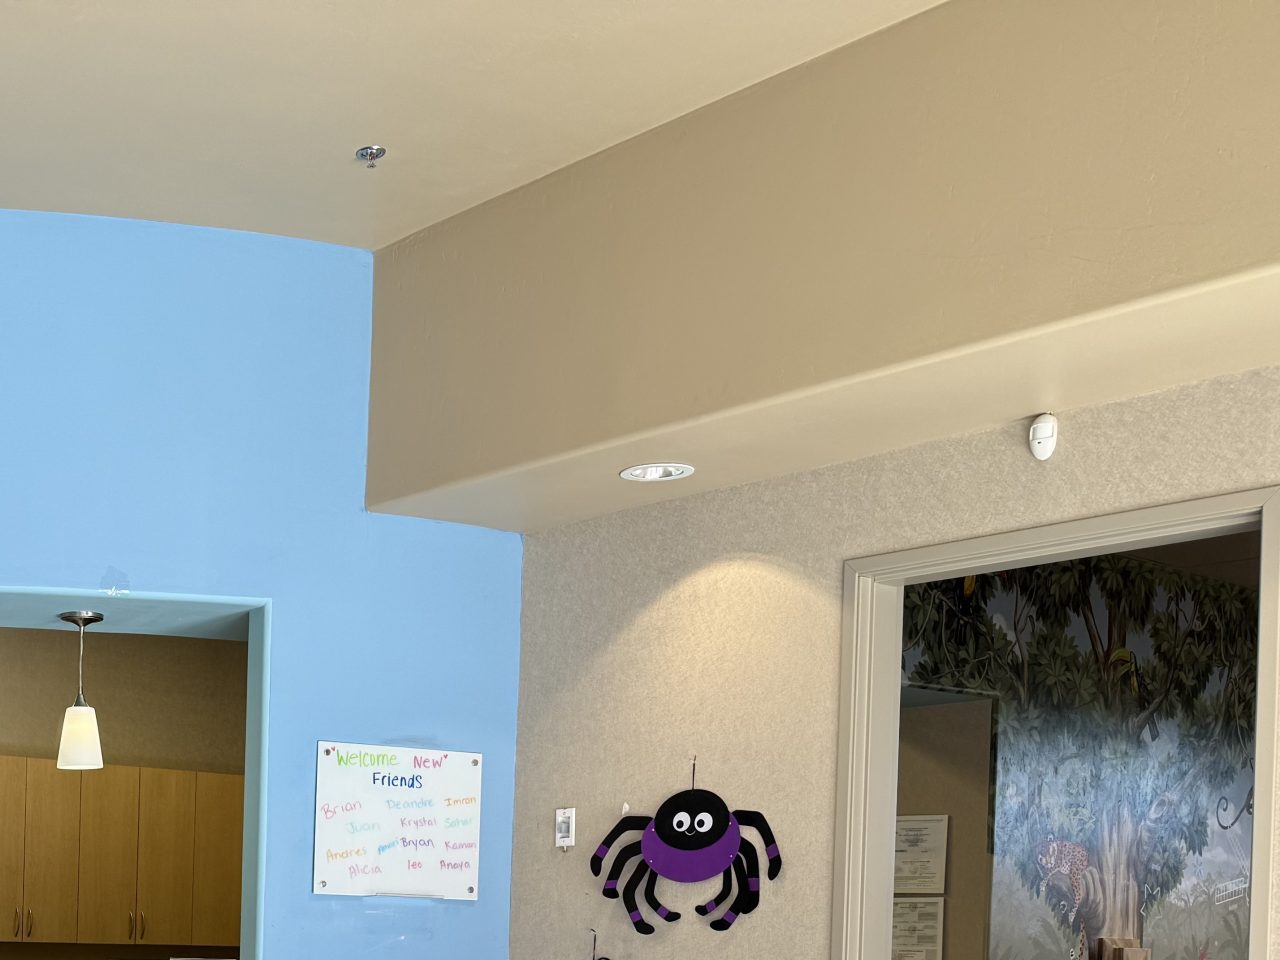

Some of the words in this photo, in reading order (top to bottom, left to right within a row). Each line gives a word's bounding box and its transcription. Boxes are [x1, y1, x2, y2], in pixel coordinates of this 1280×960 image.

[336, 749, 400, 767] Welcome
[414, 755, 443, 768] New
[372, 772, 422, 789] Friends
[320, 800, 362, 820] Brian
[345, 822, 380, 834] Juan
[400, 816, 438, 830] Krystal
[400, 837, 435, 852] Bryan
[348, 864, 382, 879] Alicia
